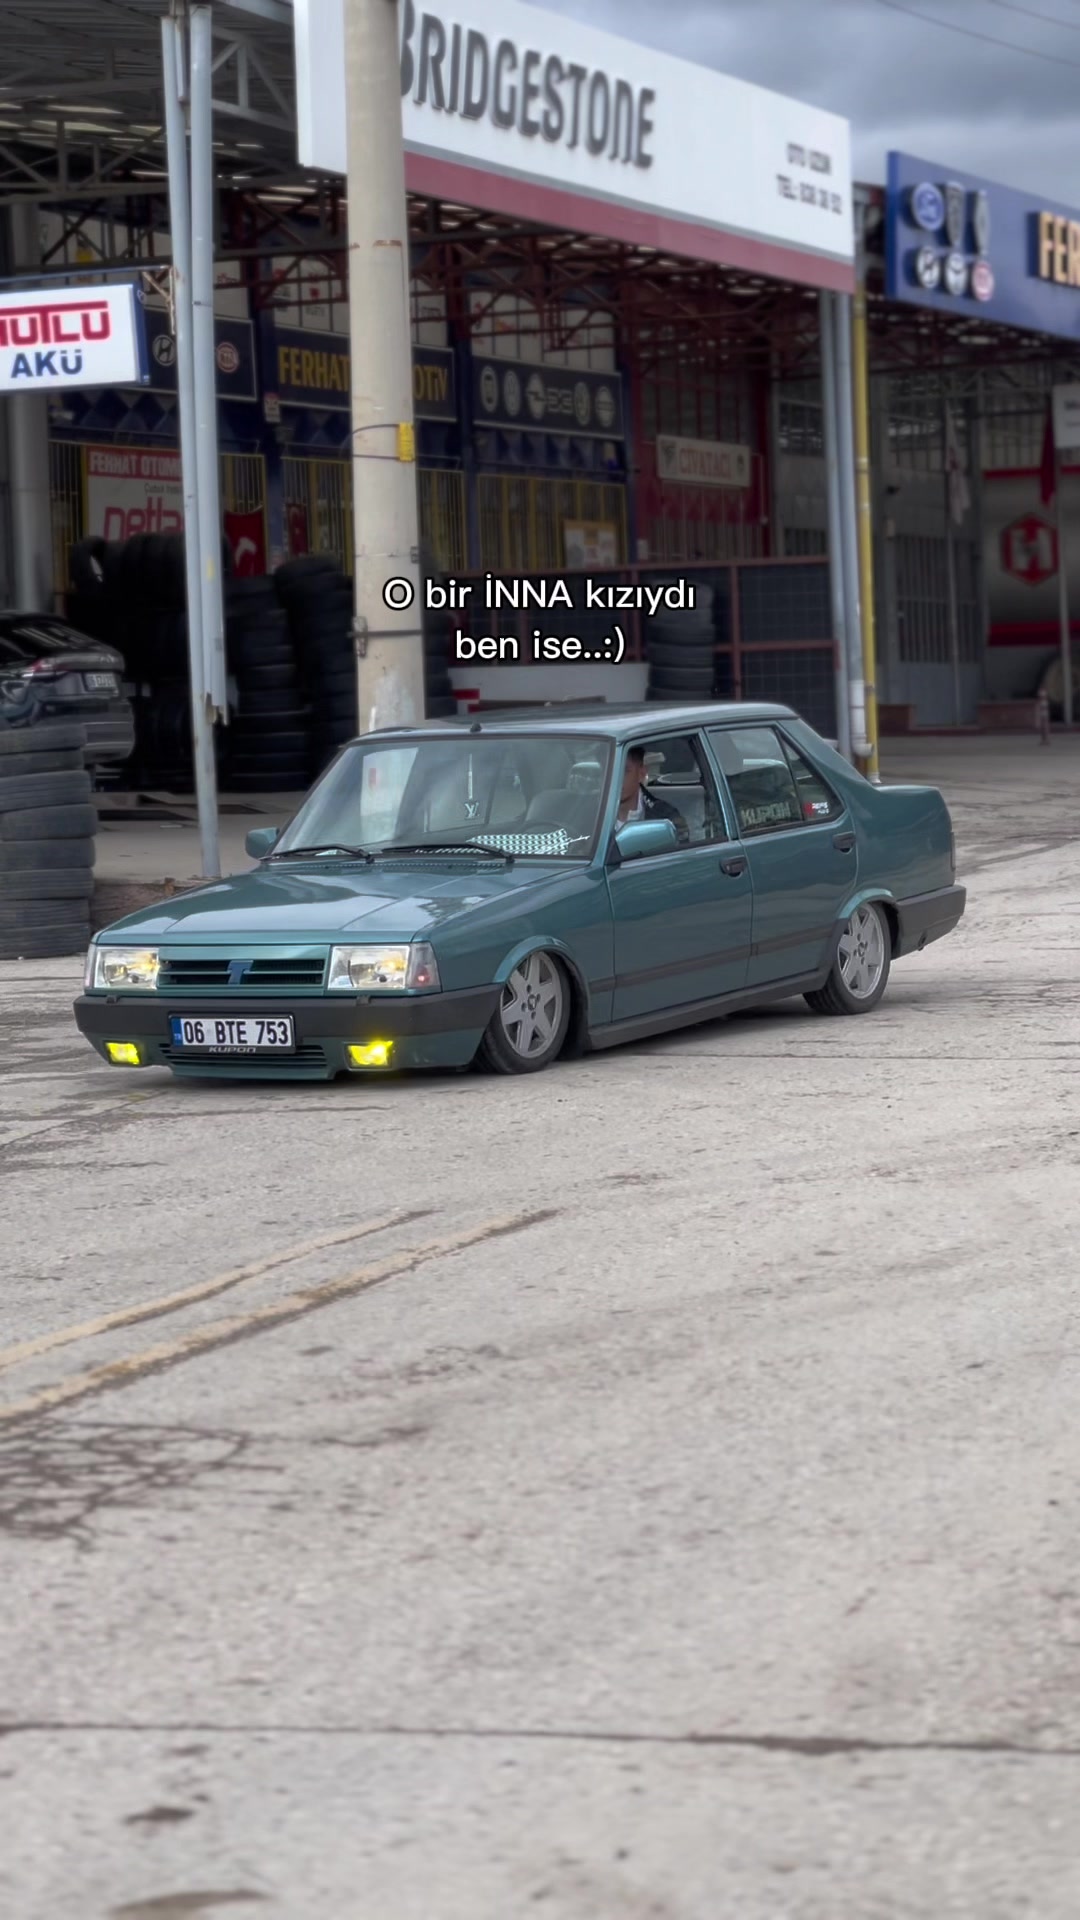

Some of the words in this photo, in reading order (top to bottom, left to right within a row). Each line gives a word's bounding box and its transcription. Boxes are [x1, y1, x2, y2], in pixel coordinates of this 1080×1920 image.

[0, 300, 111, 347] UTLU
[10, 348, 83, 379] AKÜ
[89, 451, 137, 476] FERHAT
[183, 1020, 205, 1044] 06
[214, 1020, 248, 1044] BTE
[255, 1021, 289, 1045] 753
[208, 1046, 257, 1054] KUPON
